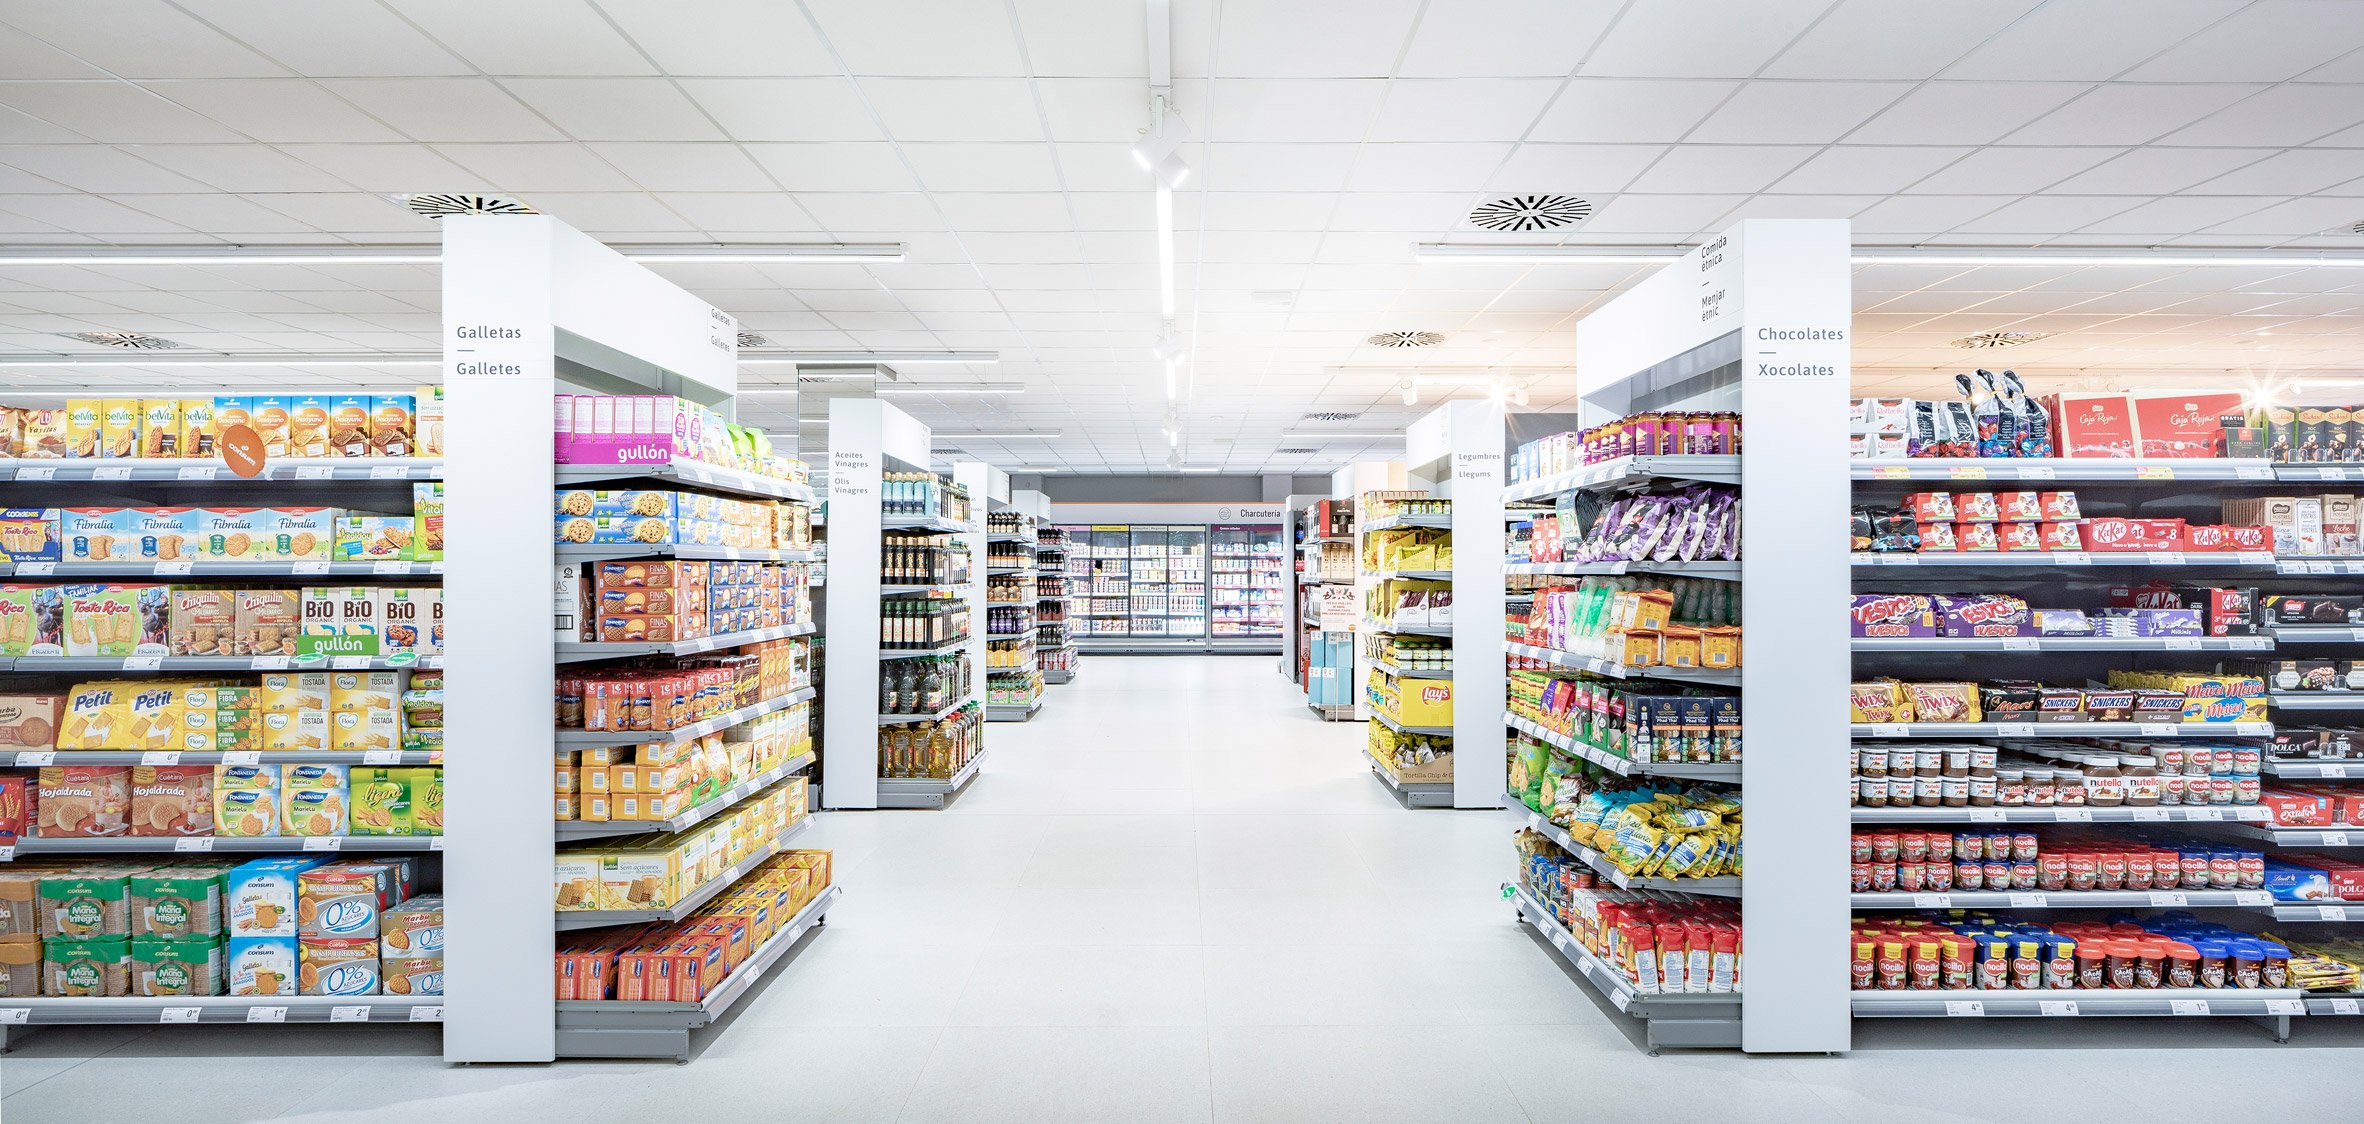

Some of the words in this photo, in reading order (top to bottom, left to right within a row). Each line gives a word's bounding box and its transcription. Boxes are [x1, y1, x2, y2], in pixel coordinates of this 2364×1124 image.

[1702, 236, 1727, 259] Comida
[1702, 289, 1726, 309] Menjar
[711, 308, 730, 326] Galletas
[457, 326, 521, 339] Galletas
[1758, 328, 1844, 340] Chocolates
[711, 335, 730, 352] Galletes
[457, 362, 521, 375] Galletes
[1759, 363, 1834, 376] Xocolates
[69, 412, 98, 422] belVita
[105, 412, 135, 422] belVita
[145, 410, 175, 421] belVita
[184, 410, 213, 421] belVita
[2080, 414, 2095, 426] Caja
[2171, 414, 2189, 427] Caja
[228, 443, 256, 466] consum
[618, 444, 668, 463] gullón
[1459, 453, 1501, 462] Legumbres
[835, 460, 869, 468] Vinagres
[1459, 471, 1491, 479] Llegums
[835, 487, 868, 495] Vinagres
[1240, 509, 1281, 518] Charcuteria
[74, 518, 115, 530] Fibralia
[142, 518, 184, 530] Fibralia
[211, 518, 252, 530] Fibralia
[278, 517, 317, 529] Fibralia
[2096, 523, 2125, 543] KitKat
[2194, 530, 2220, 545] KitKat
[650, 565, 668, 573] FINAS
[72, 600, 102, 613] Tosta
[102, 600, 130, 615] Rica
[650, 618, 667, 626] FINAS
[314, 636, 363, 654] gullón
[74, 690, 113, 712] Petit
[134, 691, 173, 712] Petit
[2045, 698, 2079, 708] SNICKERS
[2092, 697, 2132, 707] SNICKERS
[2143, 698, 2182, 708] SNICKERS
[2090, 778, 2122, 787] nutella
[39, 787, 92, 798] Hojaldrada
[133, 787, 185, 797] Hojaldrada
[2068, 863, 2093, 871] nocilla
[2181, 862, 2207, 870] nocilla
[72, 906, 97, 914] María
[158, 905, 182, 914] María
[326, 900, 362, 926] 0%
[69, 914, 102, 924] Integral
[156, 914, 186, 923] Integral
[1880, 963, 1904, 971] nocilla
[159, 968, 182, 978] María
[156, 977, 188, 987] Integral
